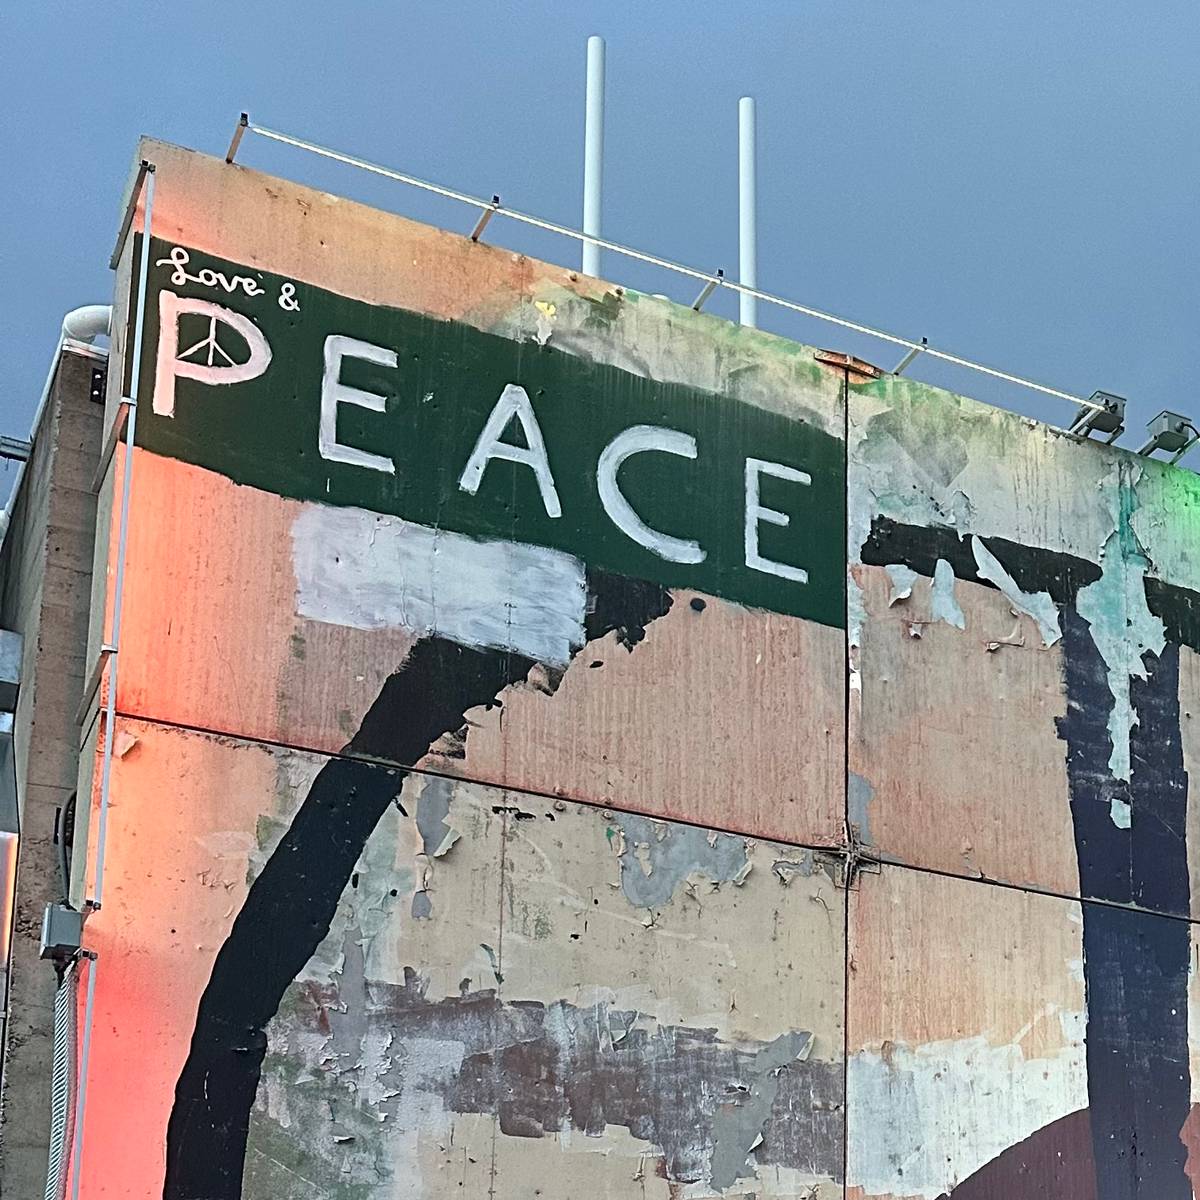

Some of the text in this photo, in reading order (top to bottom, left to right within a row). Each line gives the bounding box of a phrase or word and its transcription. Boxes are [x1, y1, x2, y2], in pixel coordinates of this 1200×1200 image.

[156, 247, 300, 312] Love &
[152, 289, 811, 585] PEACE
